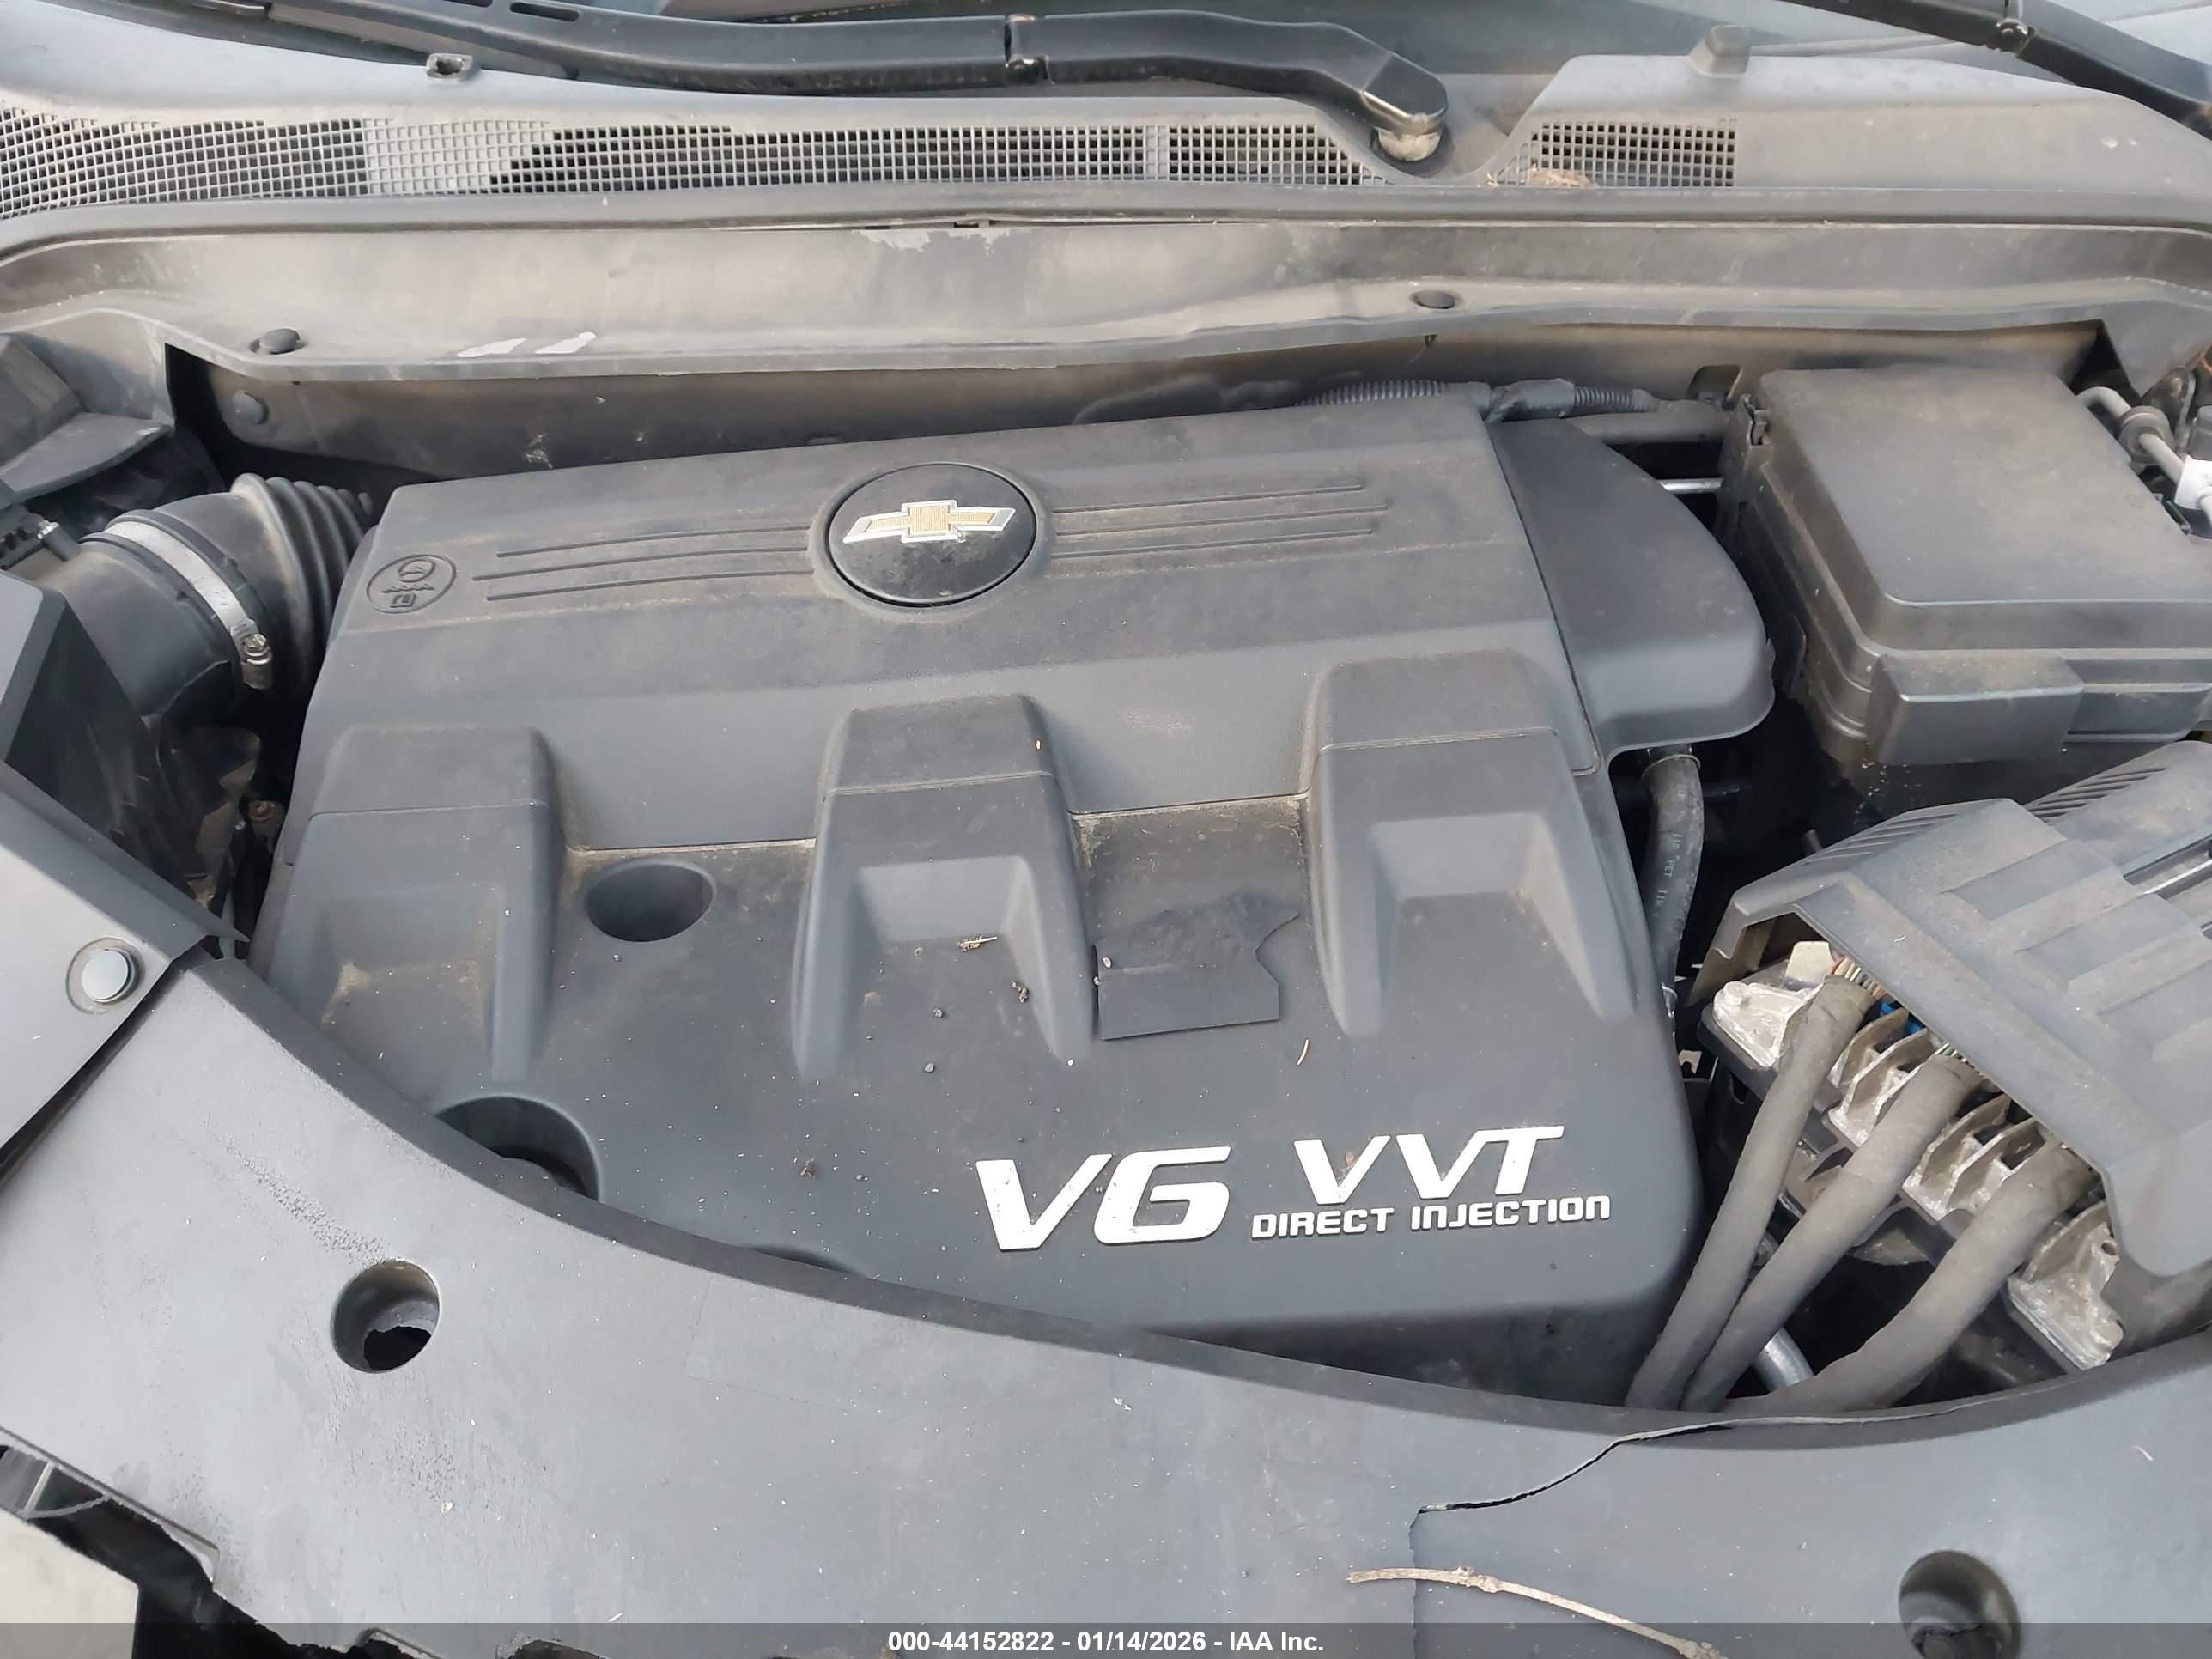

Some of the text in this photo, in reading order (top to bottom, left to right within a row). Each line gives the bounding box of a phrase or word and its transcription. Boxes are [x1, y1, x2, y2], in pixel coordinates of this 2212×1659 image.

[975, 1146, 1232, 1250] V6
[1293, 1125, 1565, 1205] VVT
[1252, 1195, 1611, 1239] DIRECT INJECTION
